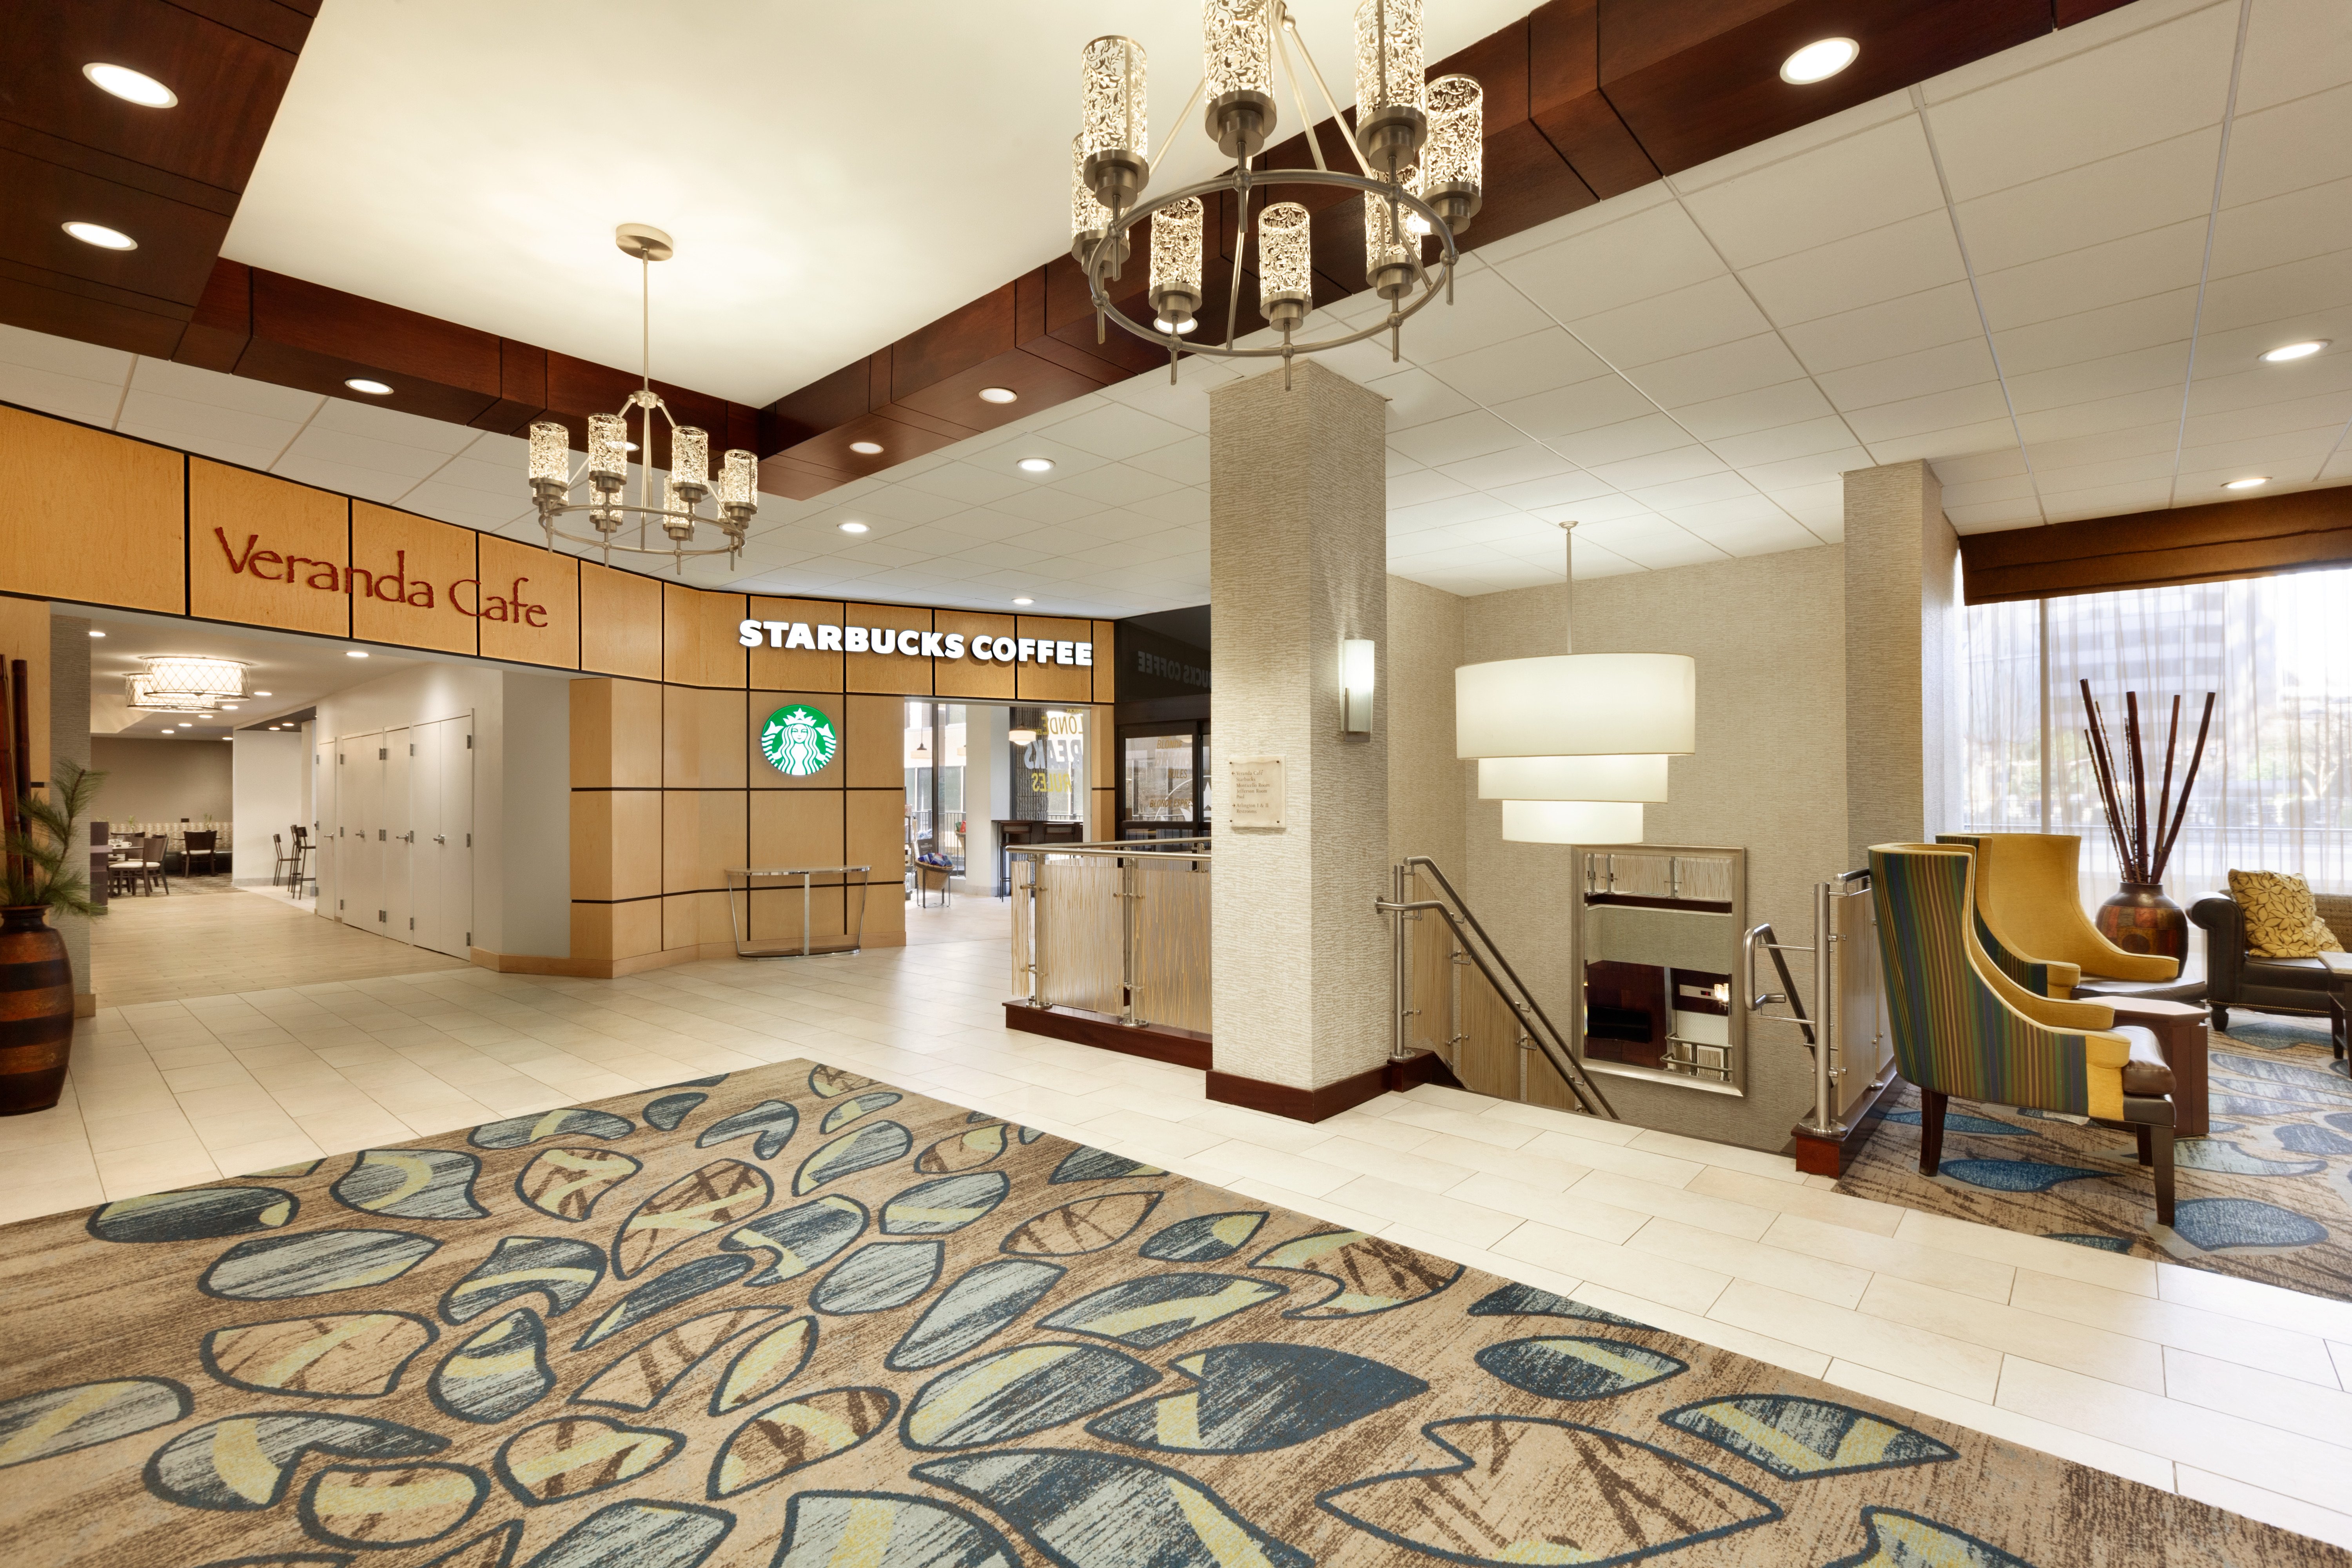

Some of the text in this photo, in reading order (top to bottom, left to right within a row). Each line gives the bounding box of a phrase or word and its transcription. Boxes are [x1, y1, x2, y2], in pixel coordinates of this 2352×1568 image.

[215, 526, 548, 627] Veranda Cafe
[739, 619, 1093, 666] STARBUCKS COFFEE
[1157, 739, 1183, 749] BLONDE
